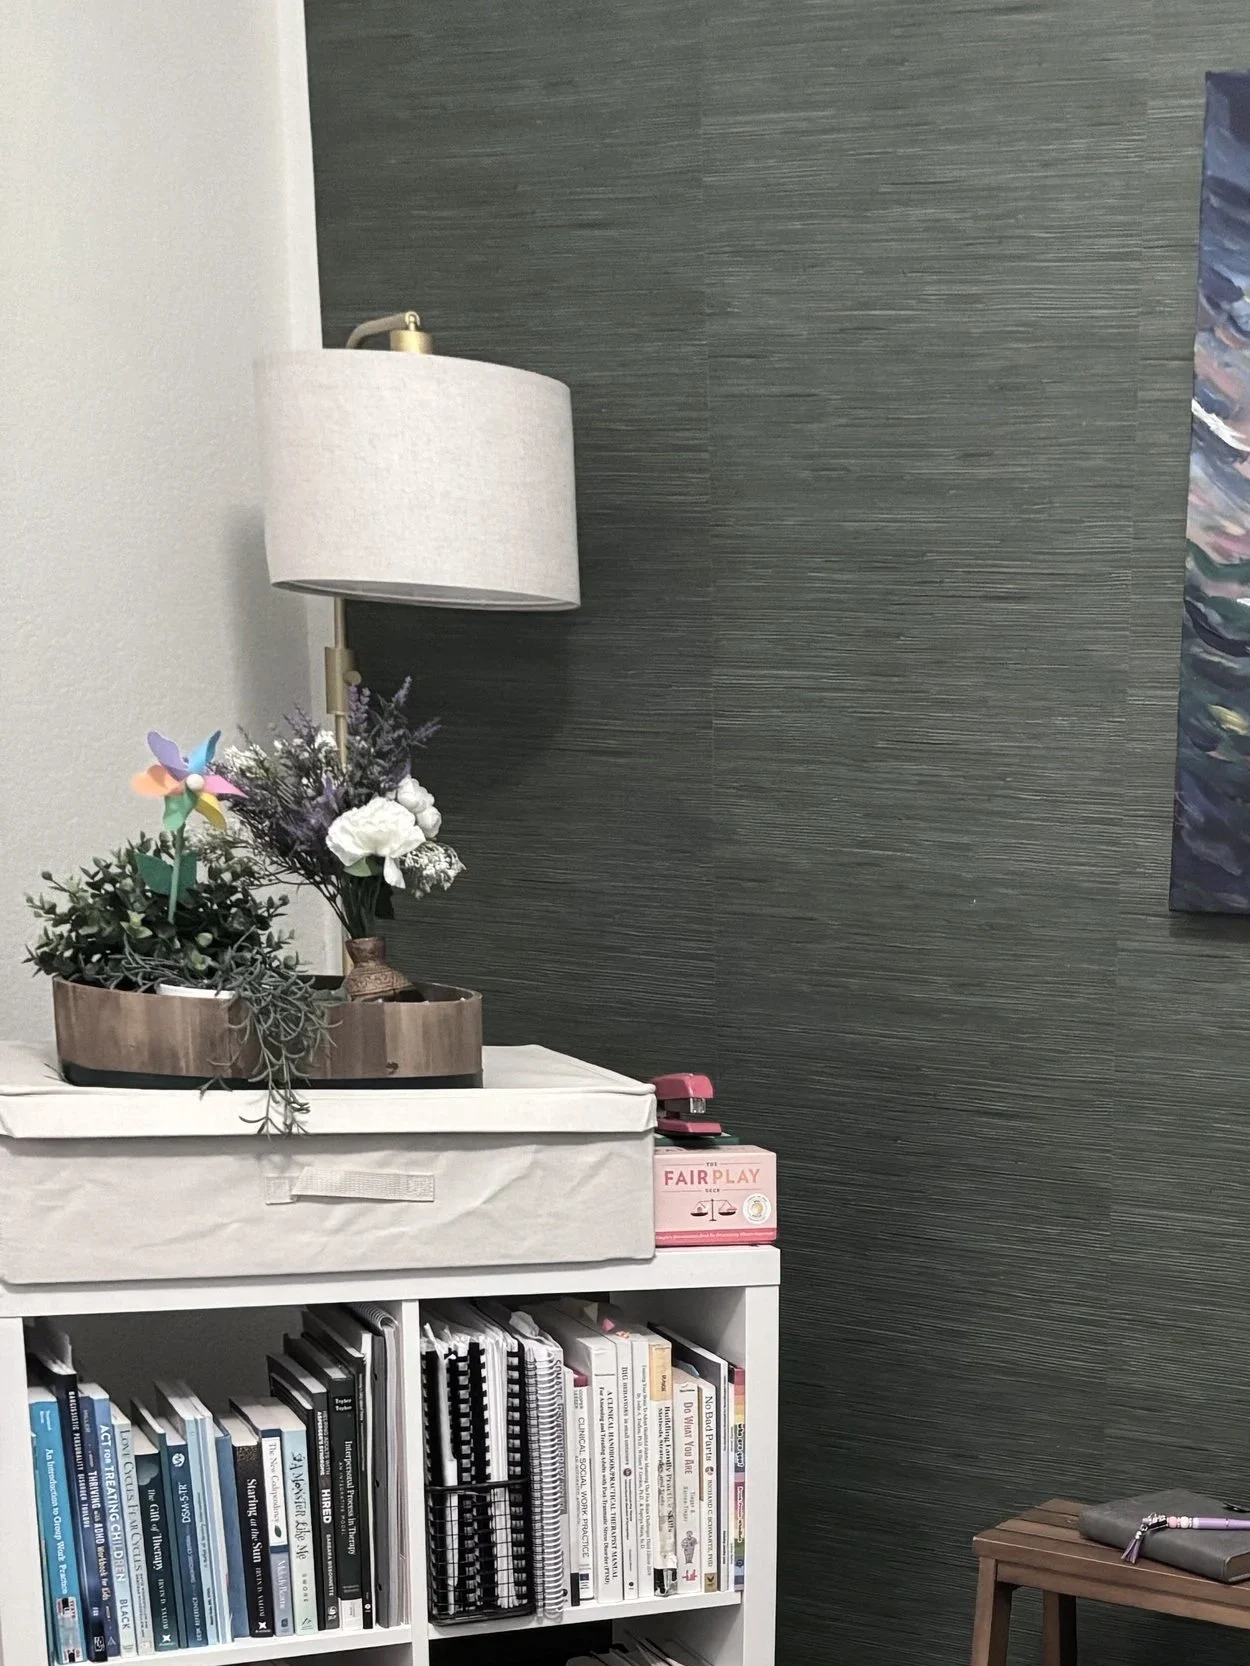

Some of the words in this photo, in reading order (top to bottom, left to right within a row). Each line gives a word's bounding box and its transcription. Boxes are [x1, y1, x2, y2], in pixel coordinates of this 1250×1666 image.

[705, 1396, 713, 1410] No
[664, 1406, 672, 1443] Building
[705, 1411, 714, 1431] Bad
[100, 1424, 111, 1446] ACT
[578, 1417, 586, 1453] CLINICAL
[706, 1434, 714, 1461] Parts
[45, 1449, 54, 1460] An
[73, 1432, 84, 1471] PERSONALITY
[269, 1442, 277, 1458] The
[270, 1459, 278, 1474] New
[344, 1441, 354, 1488] Interpersonal
[579, 1458, 587, 1489] SOCIAL
[46, 1461, 59, 1506] Introduction
[77, 1474, 87, 1501] DISORDER
[88, 1470, 101, 1508] THRIVING
[105, 1466, 119, 1521] TREATING
[147, 1489, 155, 1502] The
[247, 1478, 259, 1517] Staring
[270, 1475, 281, 1523] Codependency
[322, 1489, 332, 1524] HIRED
[347, 1490, 355, 1516] Process
[581, 1491, 589, 1515] WORK
[52, 1507, 59, 1516] to
[149, 1504, 161, 1522] Gift
[52, 1516, 63, 1540] Group
[95, 1523, 105, 1544] ADHD
[150, 1524, 159, 1533] of
[251, 1529, 259, 1541] the
[348, 1526, 357, 1555] Therapy
[56, 1541, 66, 1561] Work
[97, 1546, 108, 1576] Workbook
[111, 1524, 126, 1582] CHILDREN
[152, 1533, 164, 1570] Therapy
[252, 1542, 262, 1563] Sun
[58, 1564, 69, 1594] Practice
[120, 1600, 130, 1630] BLACK
[161, 1607, 169, 1630] YALOM
